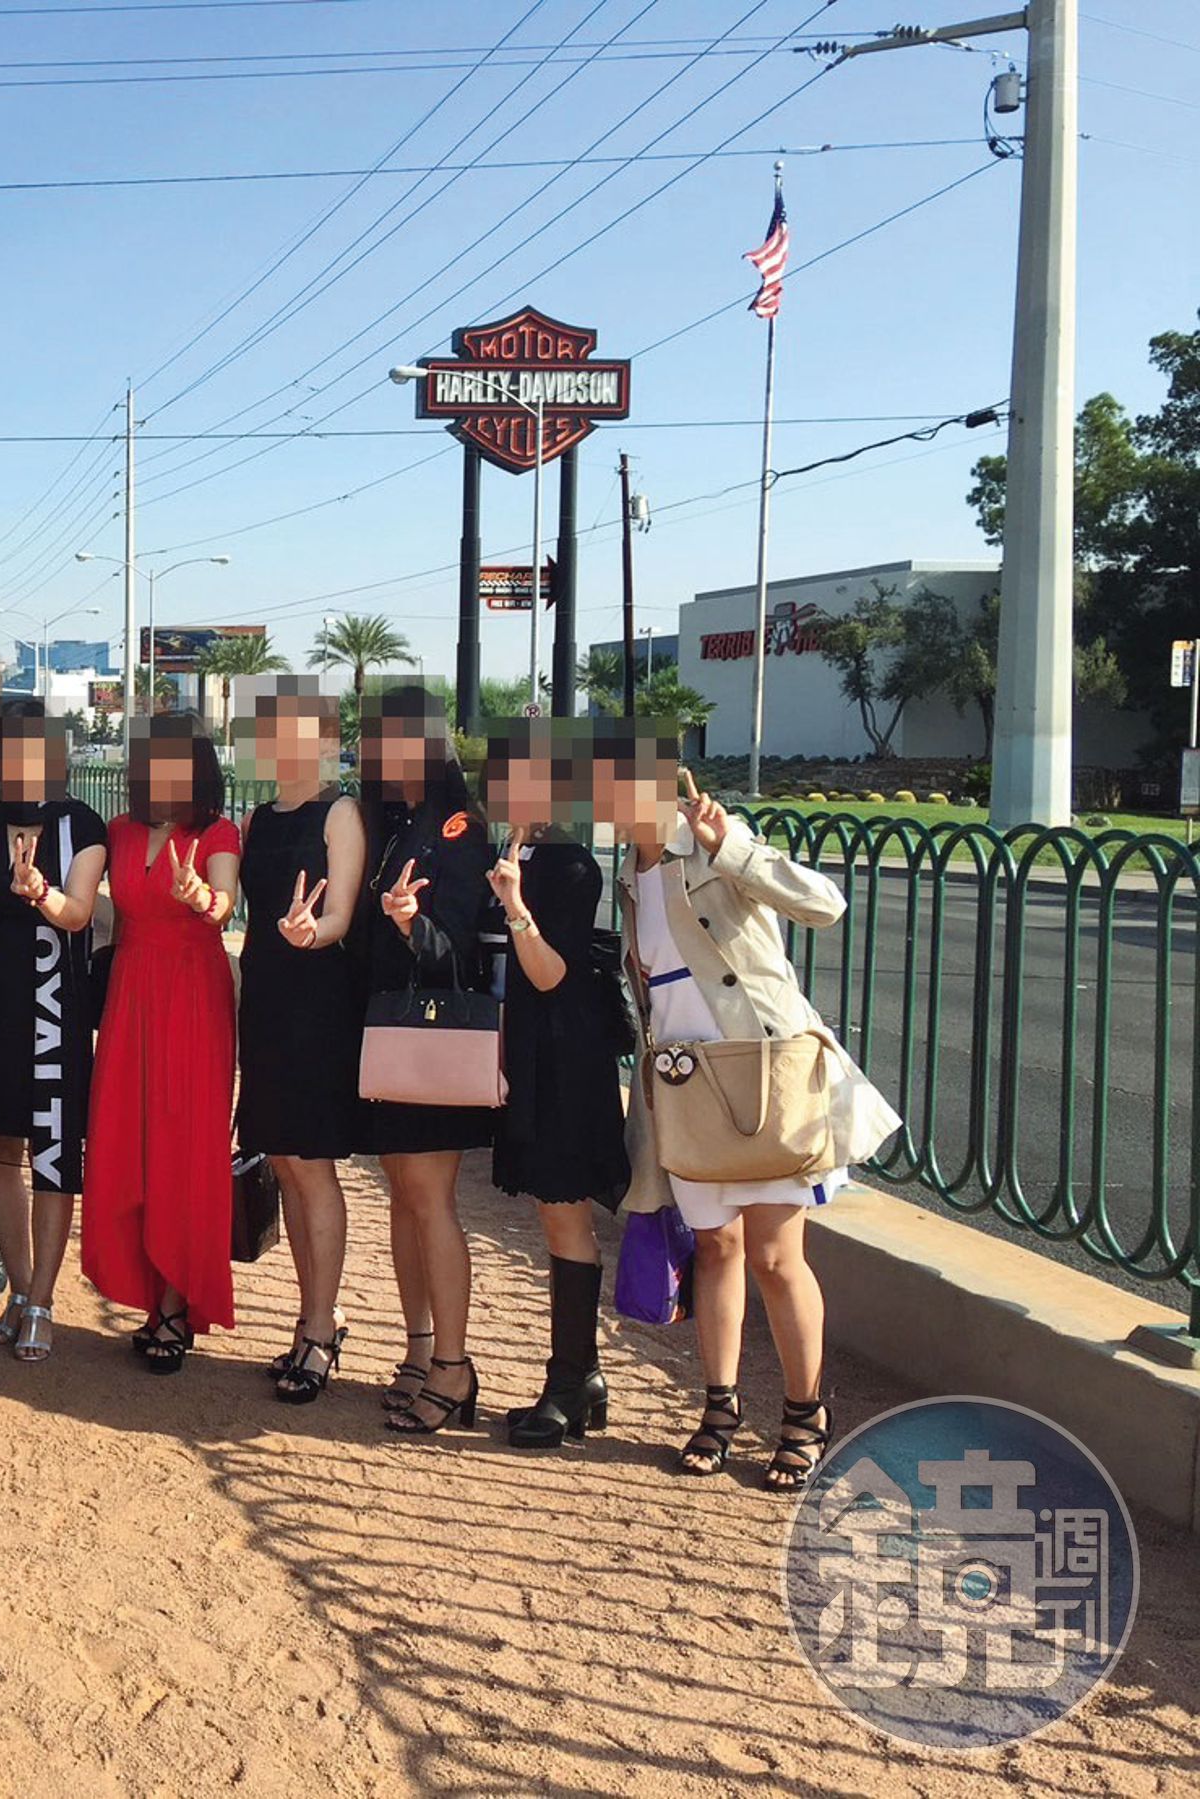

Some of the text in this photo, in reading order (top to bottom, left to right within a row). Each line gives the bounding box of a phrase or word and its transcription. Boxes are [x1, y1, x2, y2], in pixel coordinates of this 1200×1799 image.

[480, 323, 574, 360] MOTOR
[435, 369, 619, 405] HARLEY-DAVIDSON
[477, 416, 572, 457] CYCLES
